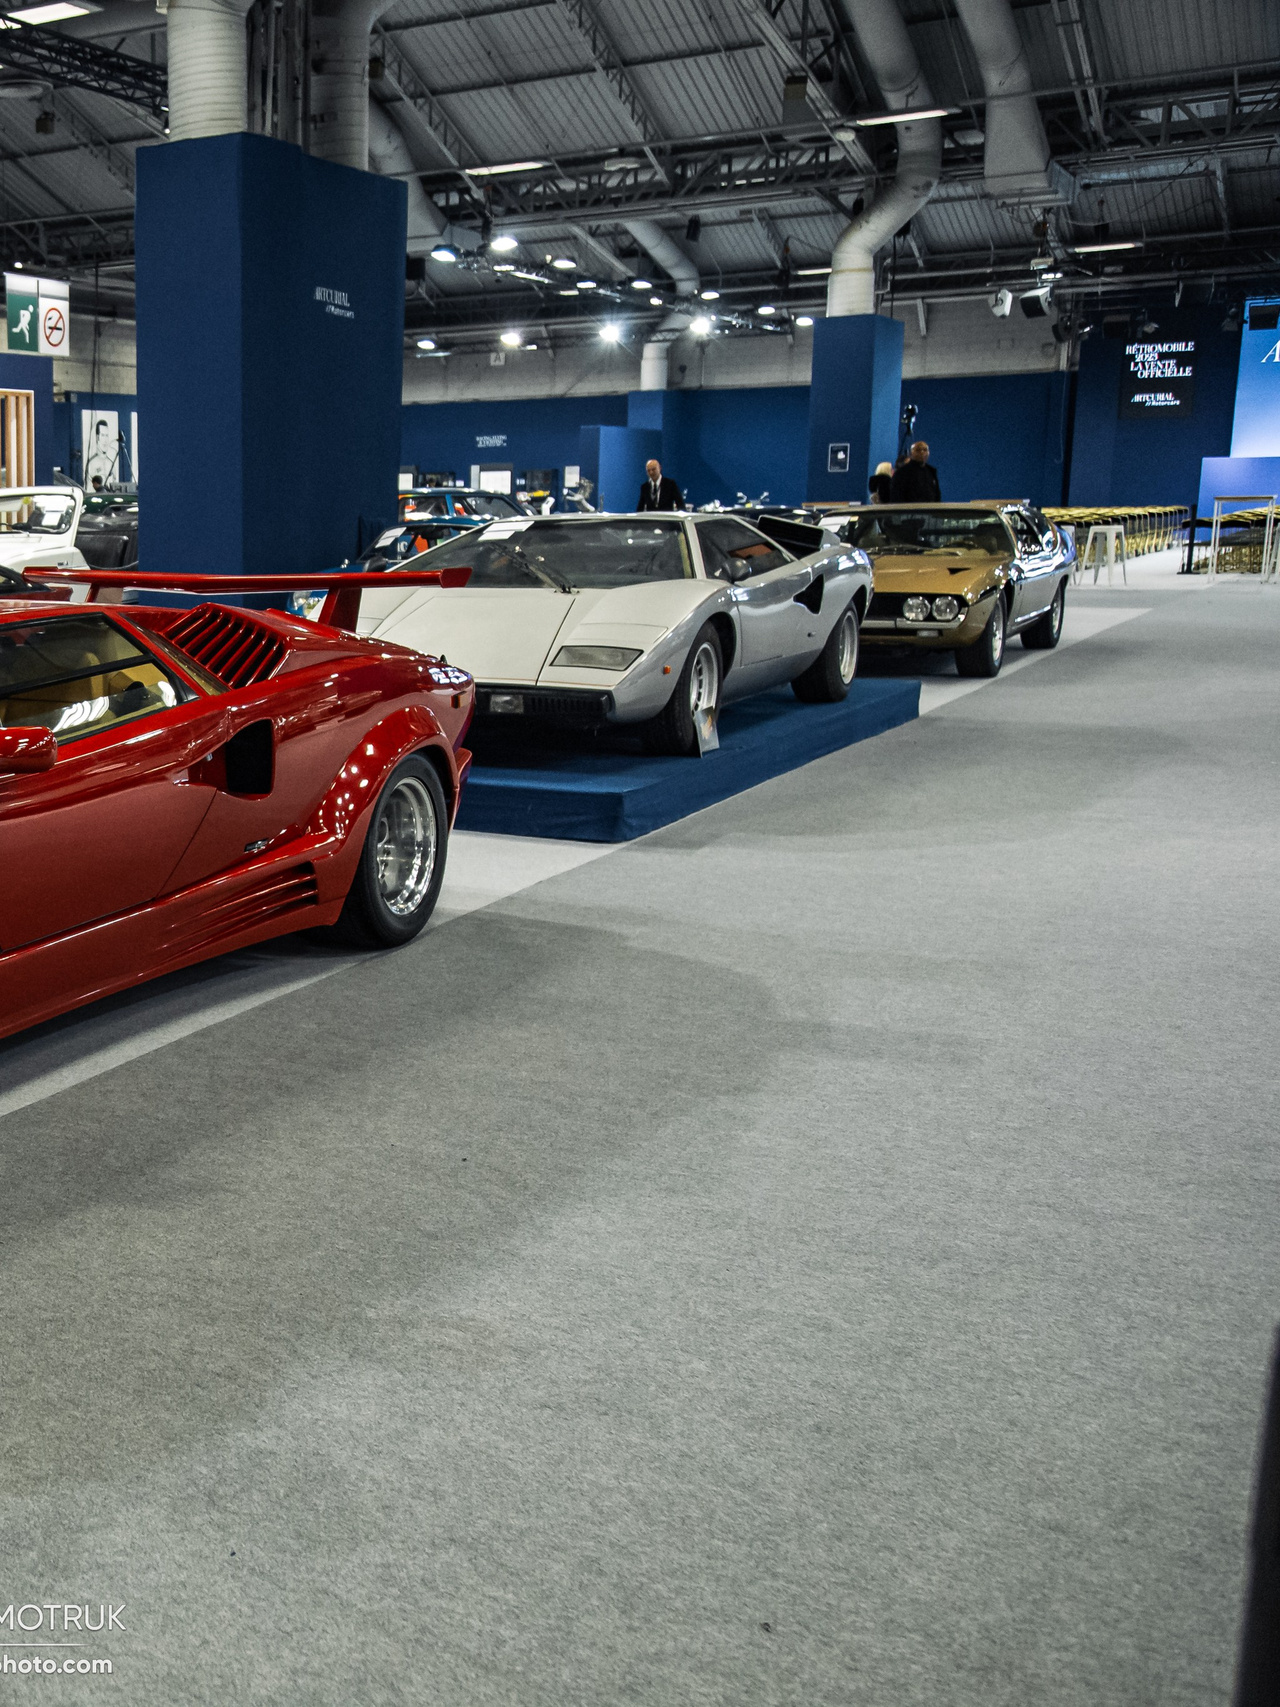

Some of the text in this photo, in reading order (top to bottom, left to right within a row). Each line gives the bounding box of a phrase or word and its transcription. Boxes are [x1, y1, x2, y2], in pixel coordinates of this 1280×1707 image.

[1125, 341, 1195, 355] RÉTROMOBILE
[1130, 359, 1177, 371] LA VENTE
[1137, 366, 1193, 379] OFFICIELLE
[1130, 392, 1175, 402] ARTCURIAL
